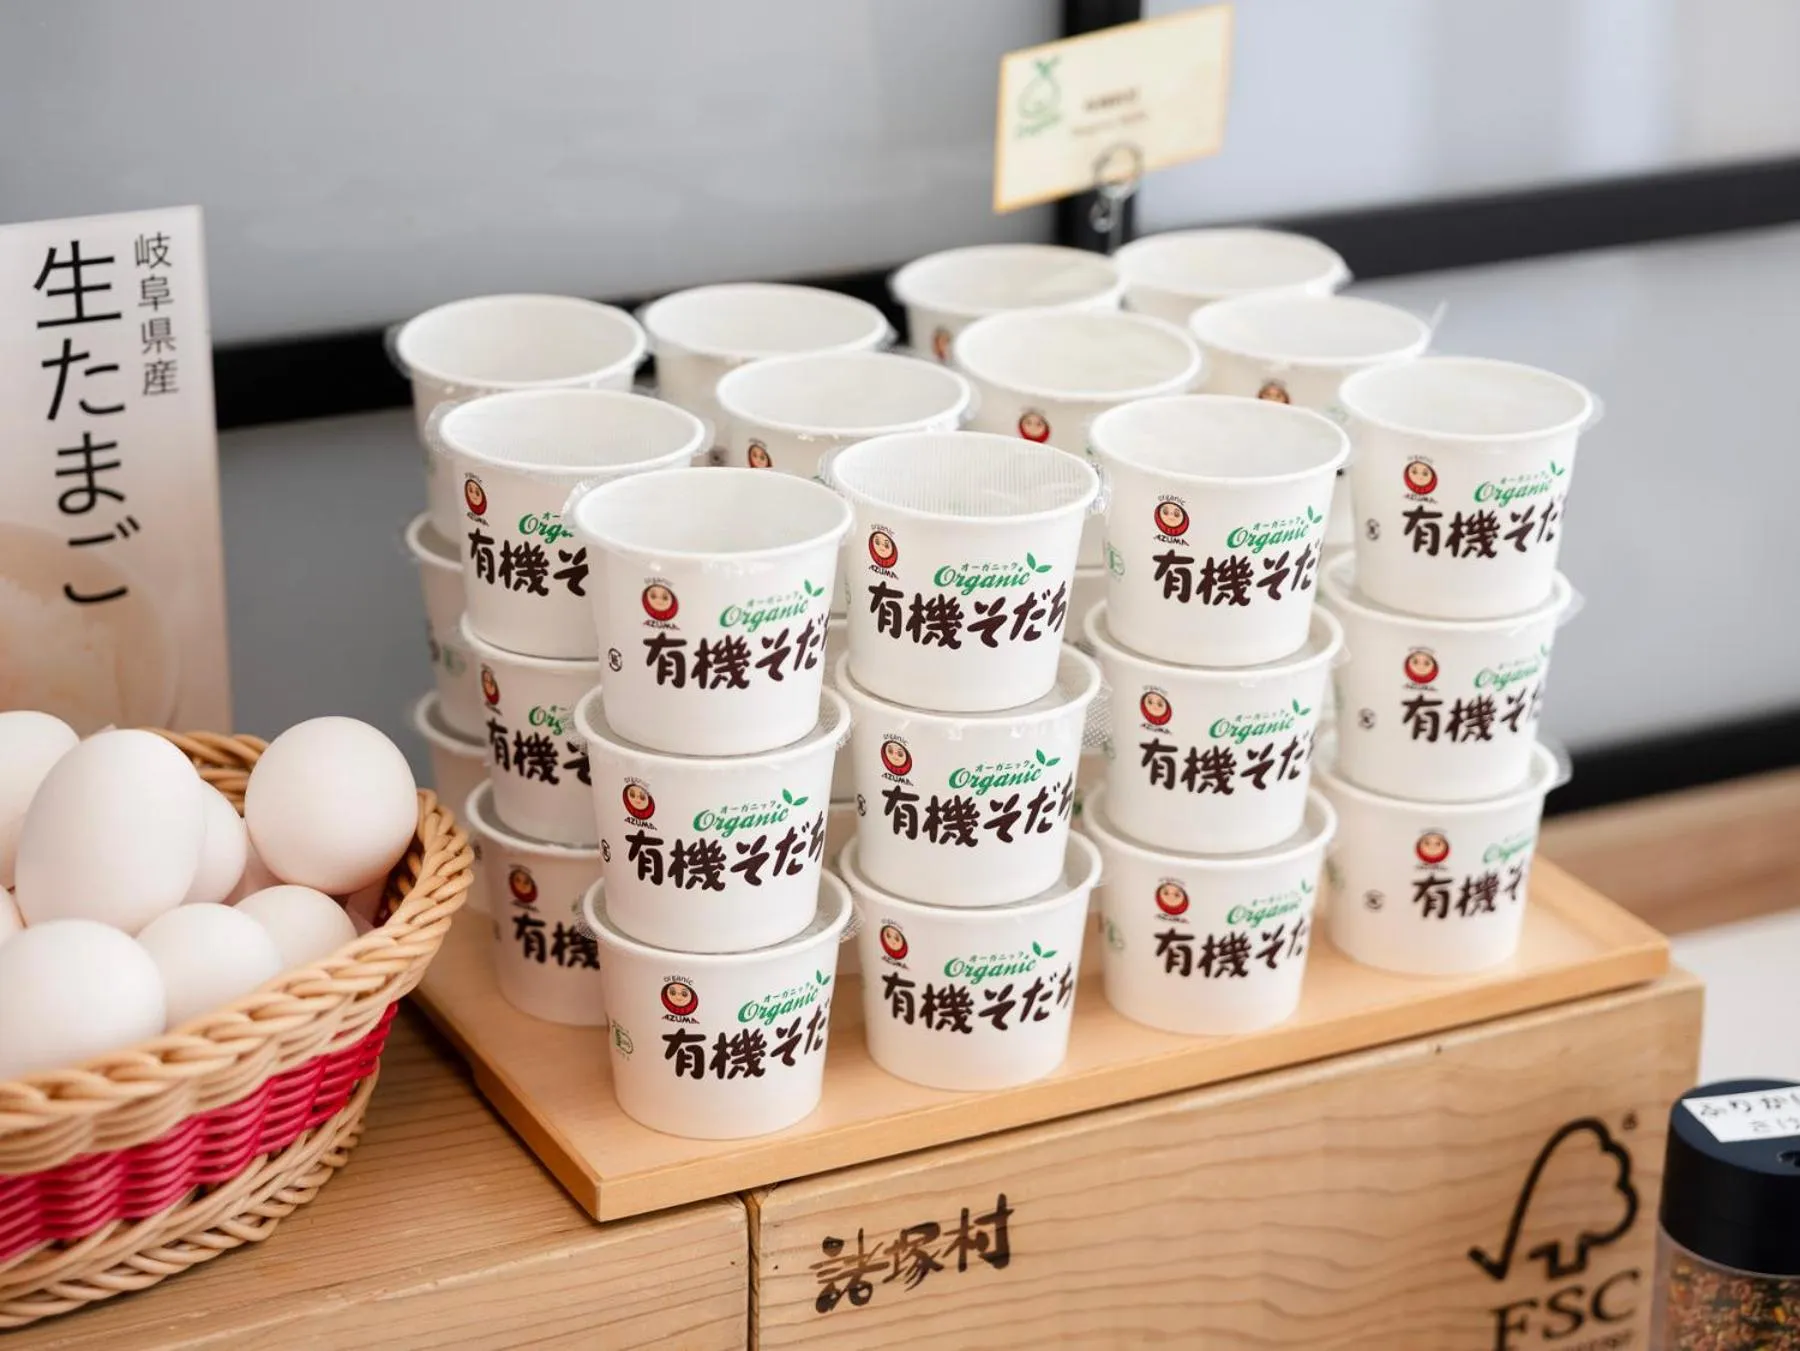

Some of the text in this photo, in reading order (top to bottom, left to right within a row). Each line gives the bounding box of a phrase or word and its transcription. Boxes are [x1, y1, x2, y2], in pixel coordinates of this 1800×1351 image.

[135, 231, 179, 396] 岐阜県産
[33, 240, 141, 606] 生たまご
[1227, 520, 1309, 553] Organic
[934, 565, 1030, 595] Organic
[719, 594, 808, 632] Organic
[643, 610, 830, 689] 有機そだ
[948, 764, 1041, 796] Organic
[693, 804, 789, 838] Organic
[944, 955, 1036, 985] Organic
[661, 1014, 700, 1025] AZUMA
[738, 985, 818, 1026] Organic
[809, 1193, 1015, 1313] 諸塚村
[1488, 1268, 1641, 1351] FSC
